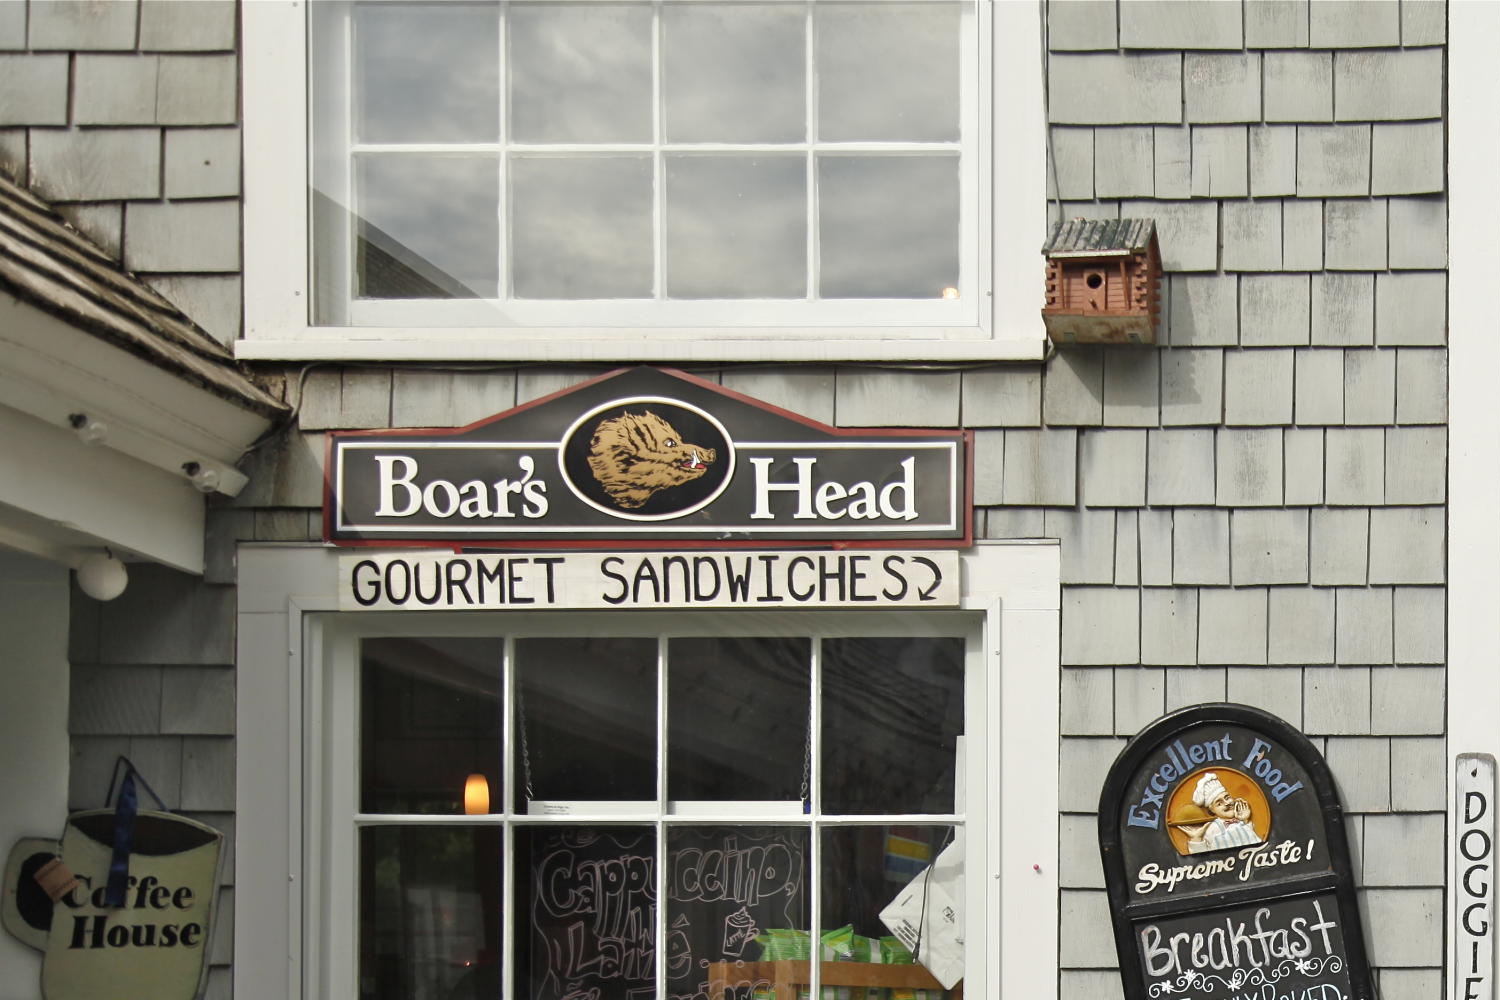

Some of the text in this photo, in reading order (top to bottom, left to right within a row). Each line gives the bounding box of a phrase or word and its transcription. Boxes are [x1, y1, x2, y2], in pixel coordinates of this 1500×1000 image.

[374, 454, 919, 521] Boar's Head
[351, 553, 908, 606] GOURMET SANDWICHES
[1127, 731, 1305, 831] Excellent Food
[1135, 855, 1236, 894] Supreme
[68, 914, 201, 949] House
[1140, 900, 1337, 978] Breakfast
